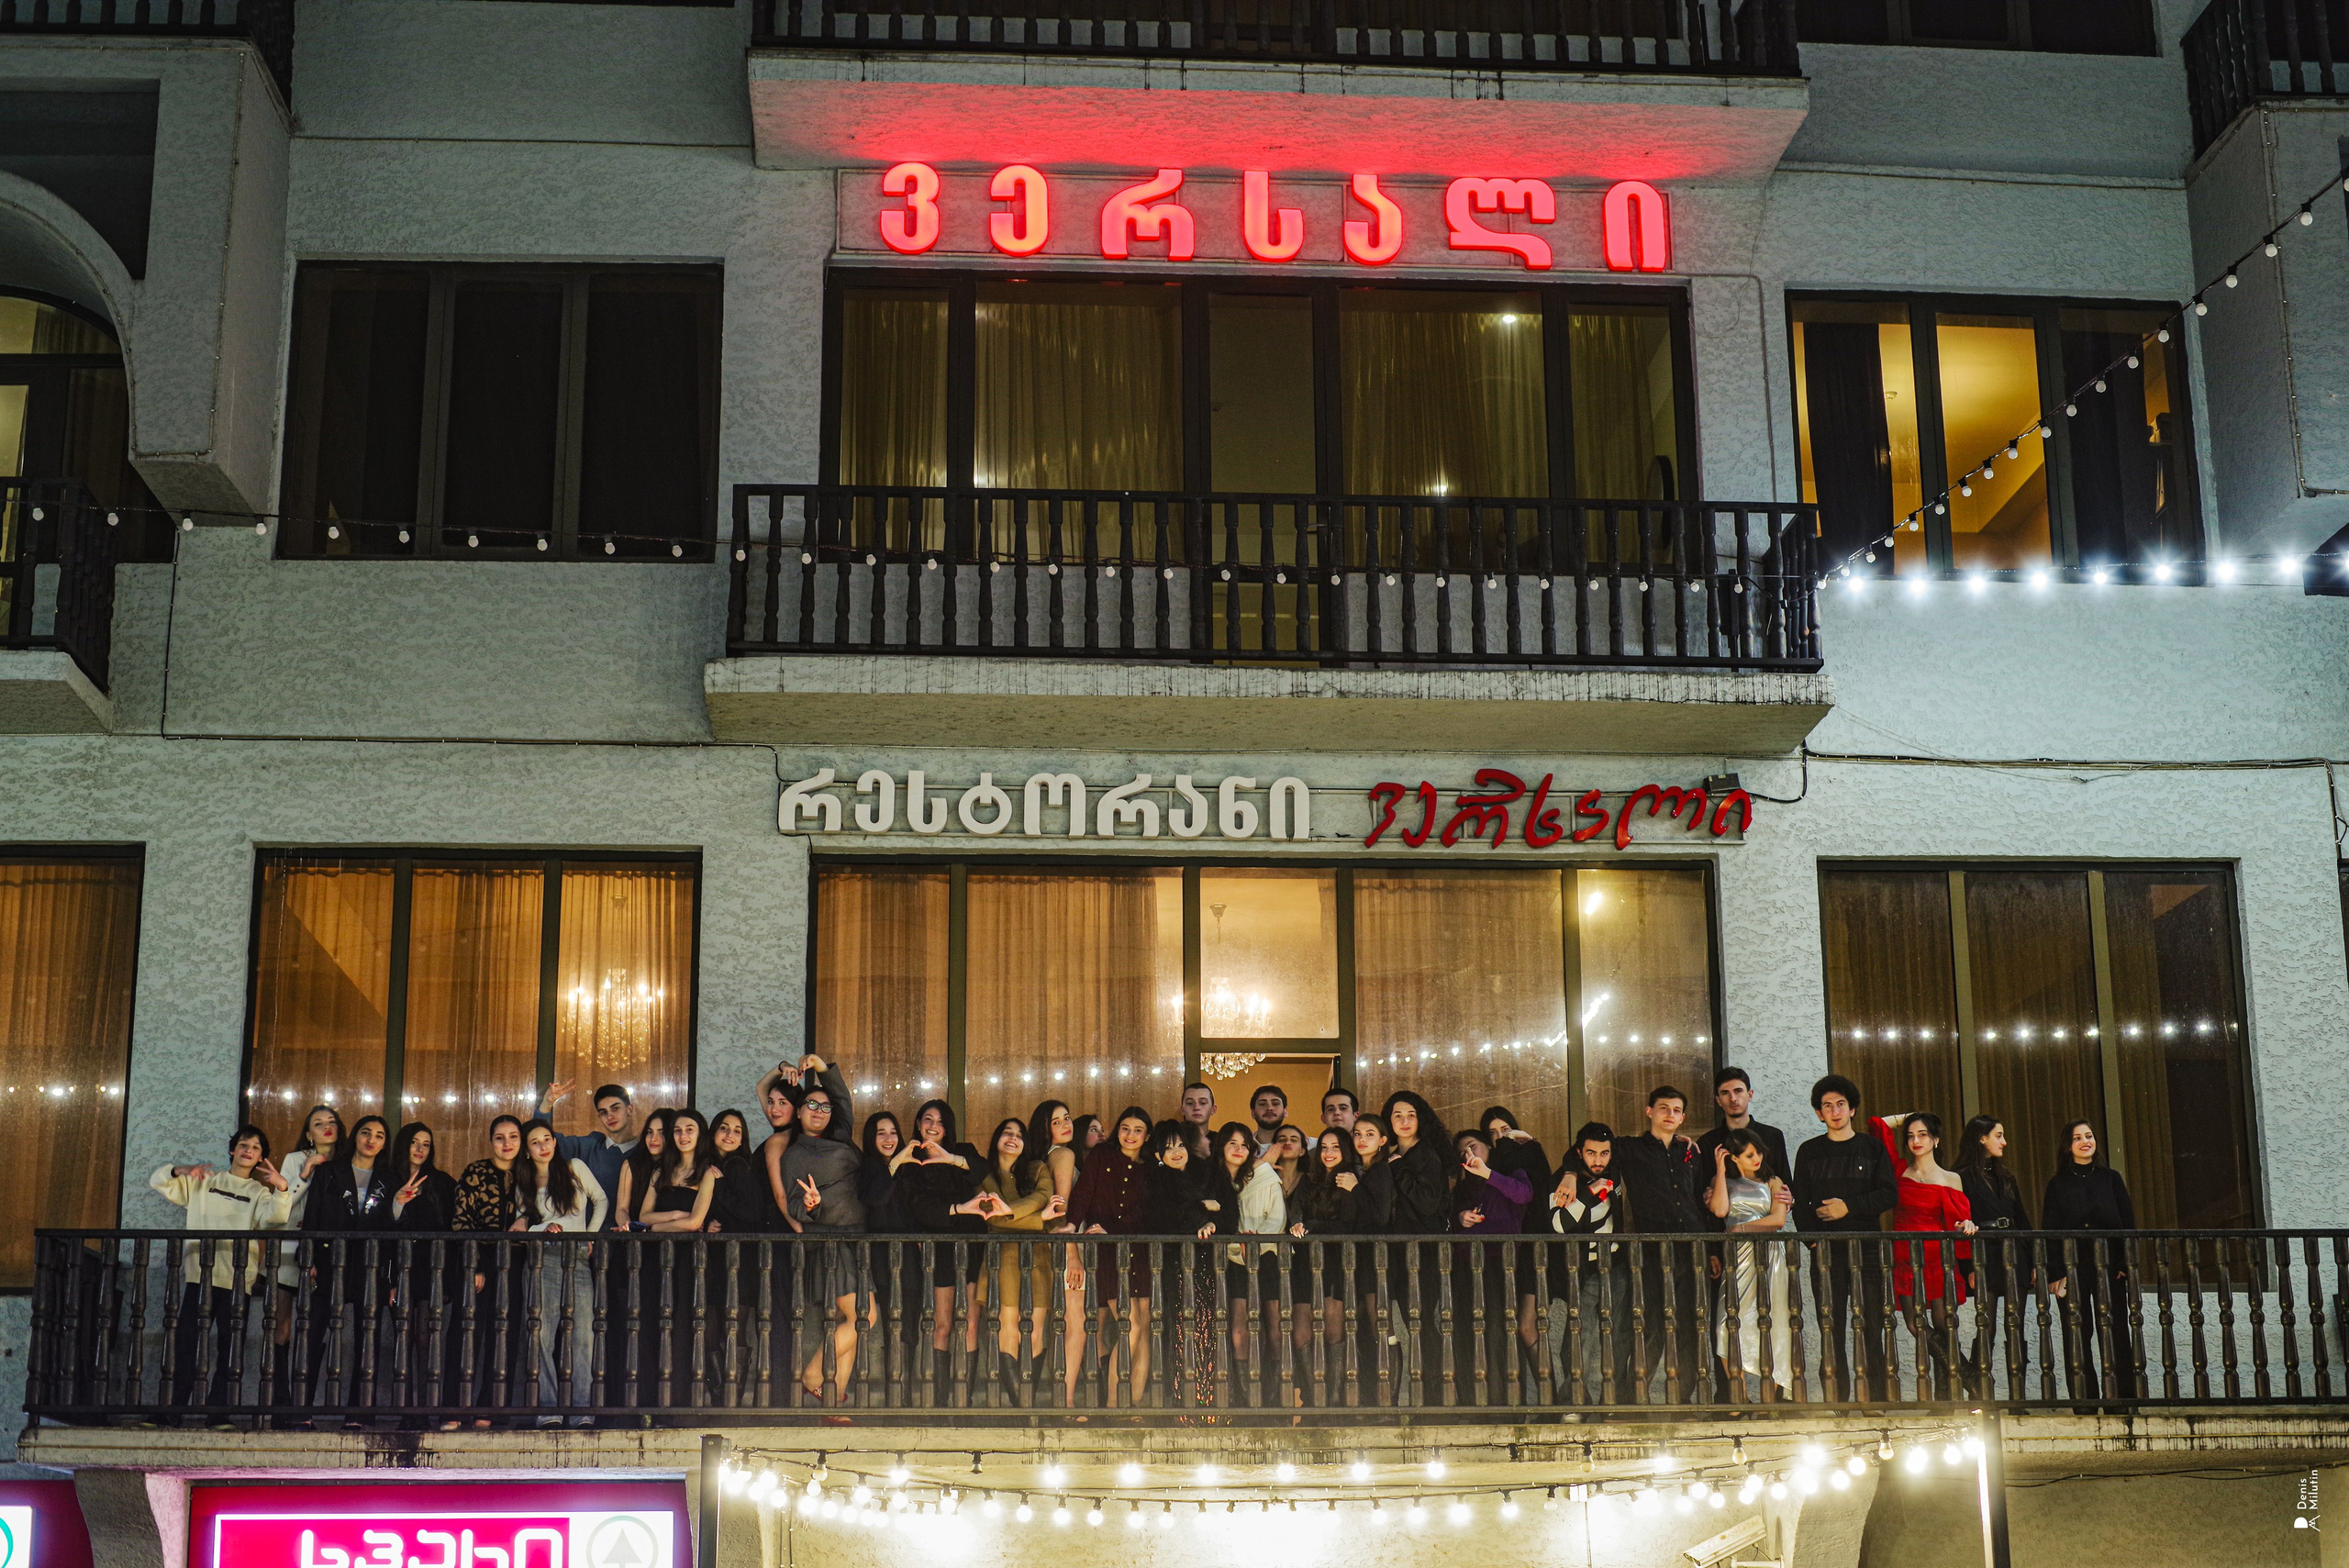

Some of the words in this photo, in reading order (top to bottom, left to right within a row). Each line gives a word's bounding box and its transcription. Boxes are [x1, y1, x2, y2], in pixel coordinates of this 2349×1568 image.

[880, 161, 1668, 272] ვერსალი
[778, 768, 1311, 841] რესტორანი
[1364, 768, 1753, 851] ვერსალი
